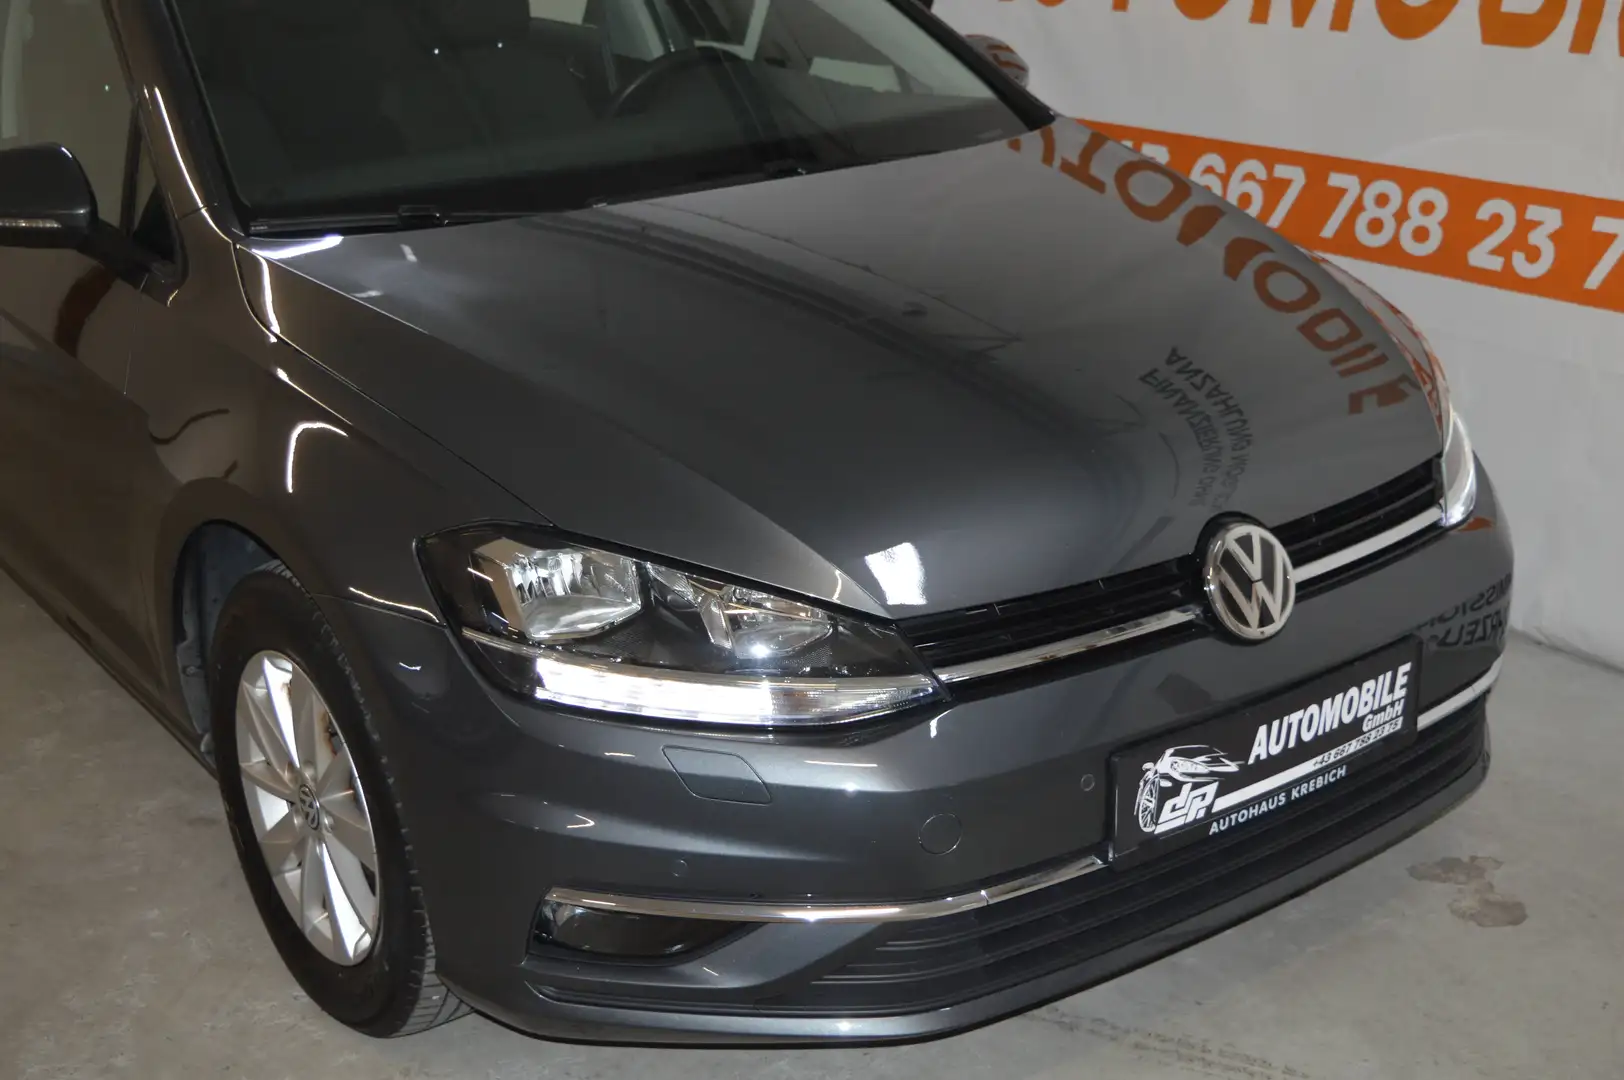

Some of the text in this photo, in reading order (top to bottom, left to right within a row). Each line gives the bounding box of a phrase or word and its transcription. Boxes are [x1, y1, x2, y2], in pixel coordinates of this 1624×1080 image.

[1188, 152, 1307, 230] 667
[1319, 171, 1449, 257] 788
[1466, 197, 1564, 280] 23
[1248, 661, 1412, 766] AUTOMOBILE
[1313, 753, 1332, 767] +43
[1333, 742, 1353, 758] 667
[1354, 733, 1372, 749] 788
[1373, 725, 1386, 740] 23
[1362, 698, 1405, 733] GmbH
[1208, 763, 1348, 835] AUTOHAUS KREBICH
